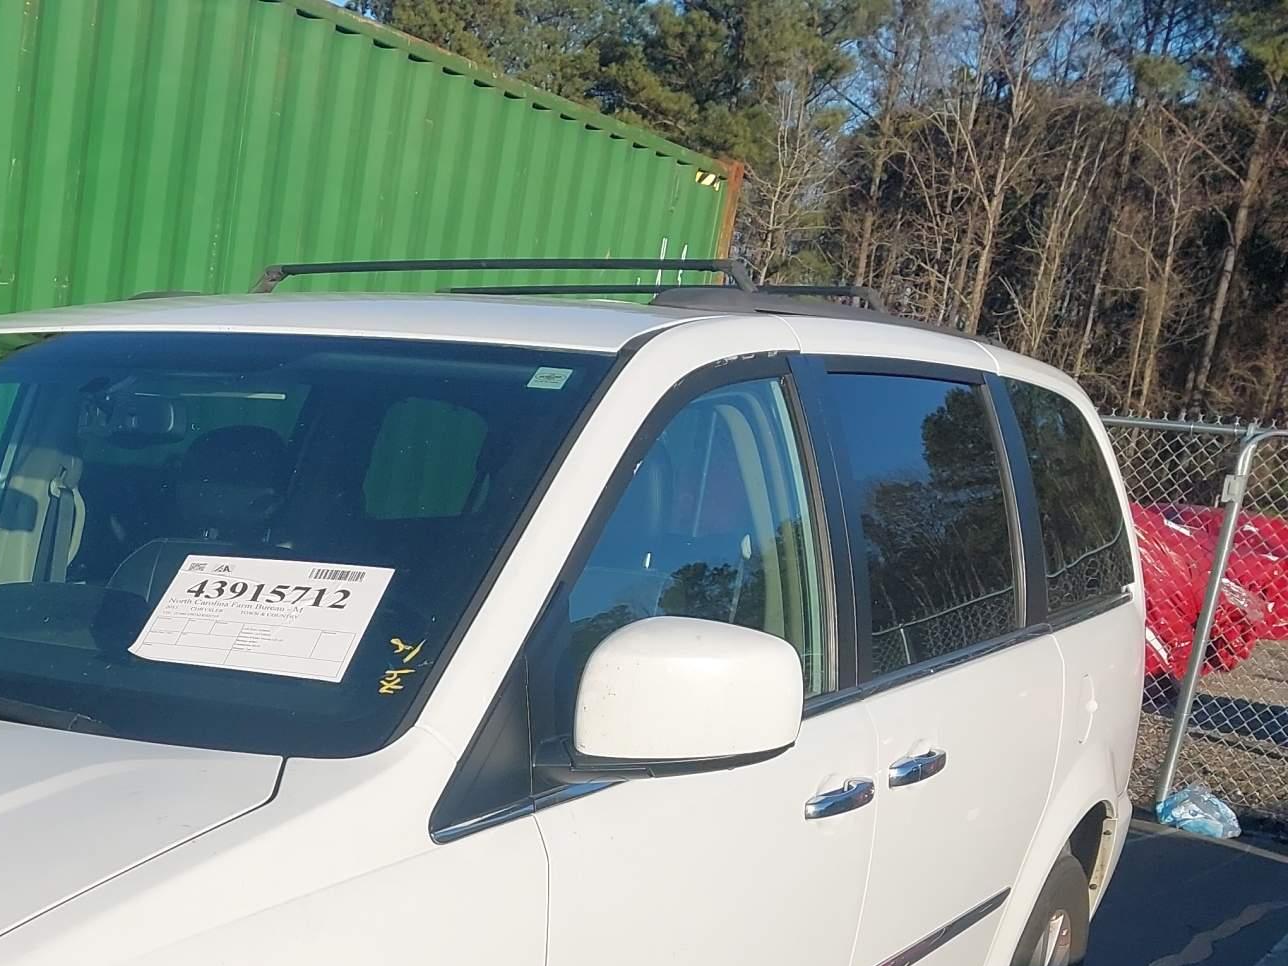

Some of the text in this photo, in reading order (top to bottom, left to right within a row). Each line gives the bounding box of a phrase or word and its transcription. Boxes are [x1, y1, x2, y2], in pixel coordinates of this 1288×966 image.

[168, 598, 193, 606] North
[194, 599, 230, 608] Carolina
[231, 601, 253, 610] Farm
[255, 603, 285, 612] Bureau
[187, 579, 351, 609] 43915712
